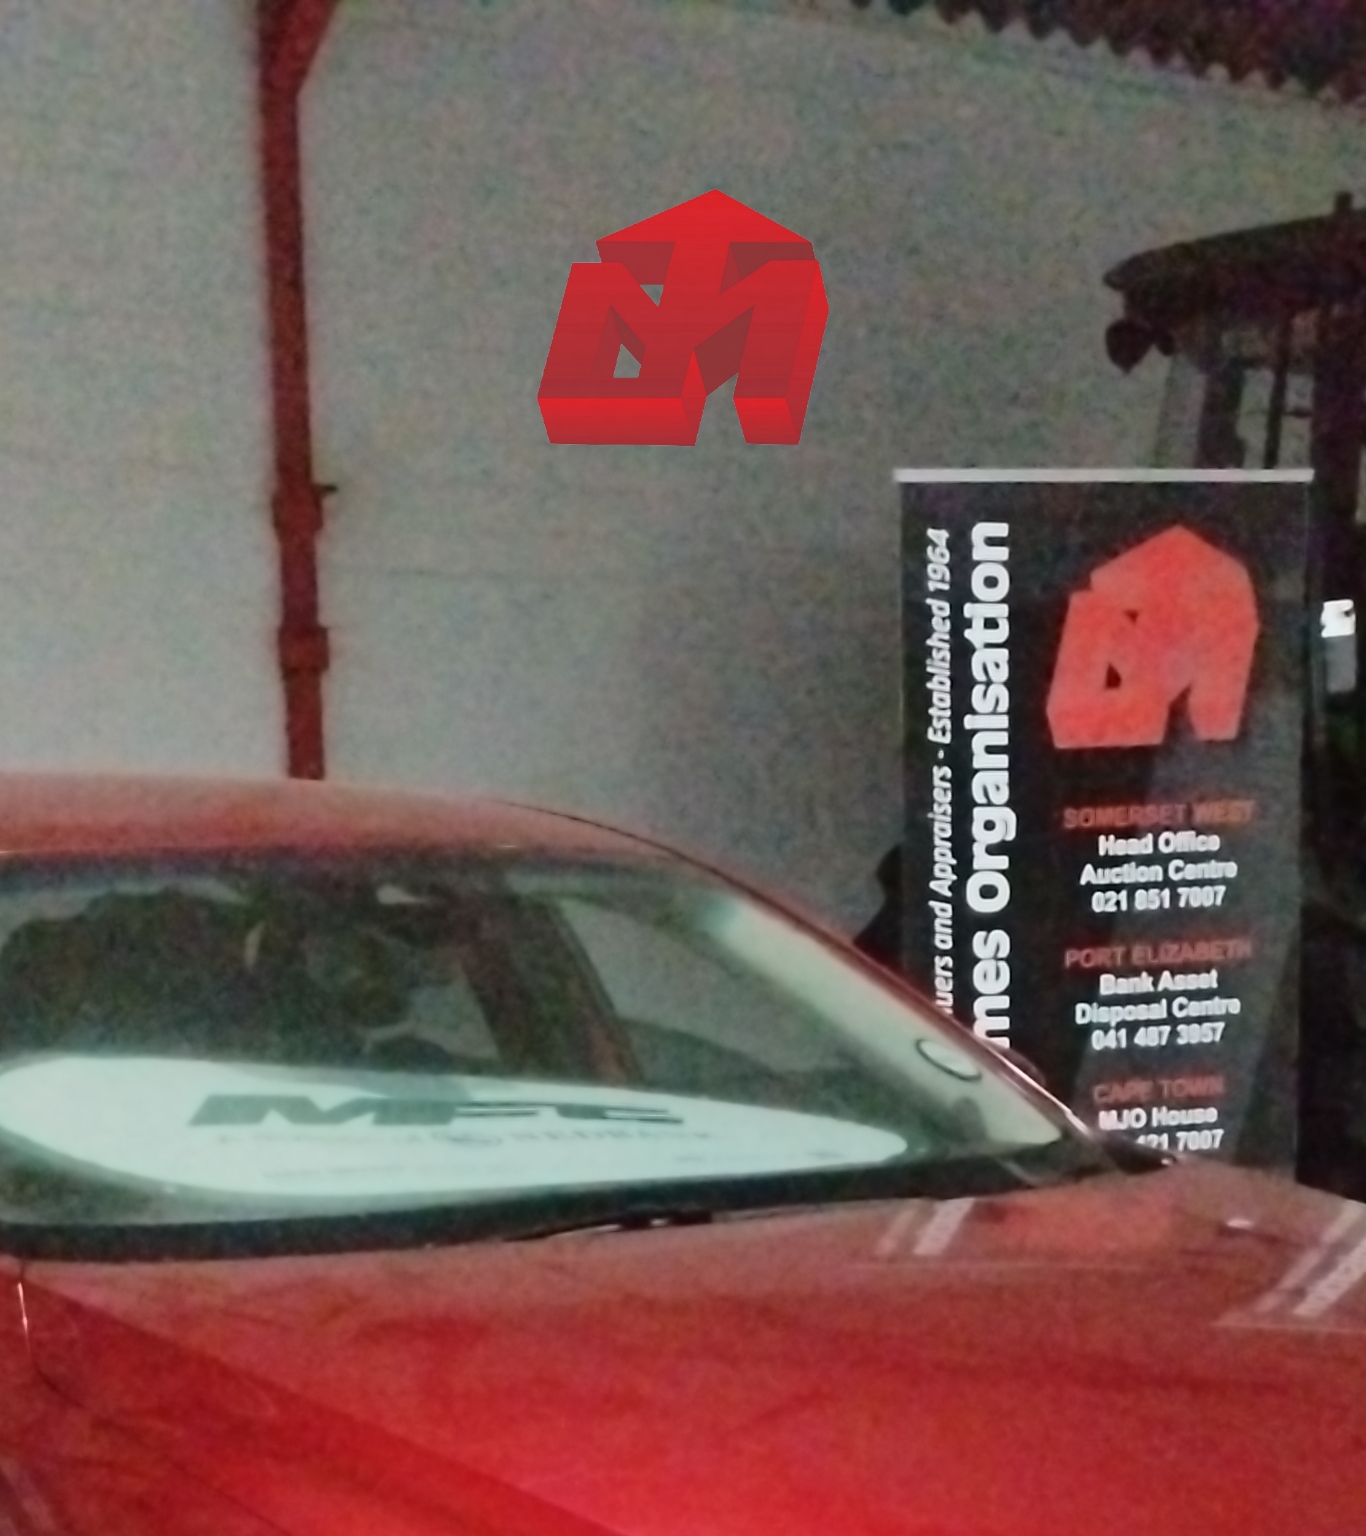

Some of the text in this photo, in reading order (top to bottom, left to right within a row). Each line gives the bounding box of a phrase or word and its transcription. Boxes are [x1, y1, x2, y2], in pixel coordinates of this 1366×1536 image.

[926, 527, 951, 592] 1964
[926, 598, 952, 745] Established
[963, 522, 1017, 1049] mes Organisation
[927, 765, 957, 898] Appraisers
[1098, 831, 1221, 856] Head Office
[1080, 859, 1238, 886] Auction Centre
[1091, 889, 1128, 914] 021
[1177, 885, 1227, 909] 7007
[928, 900, 953, 950] and
[1065, 944, 1126, 969] PORT
[927, 956, 953, 1014] uers
[1099, 968, 1219, 996] Bank Asset
[1075, 995, 1241, 1026] Disposal Centre
[1091, 1027, 1127, 1051] 041
[1098, 1105, 1218, 1132] MJO House
[1176, 1129, 1225, 1152] 7007
